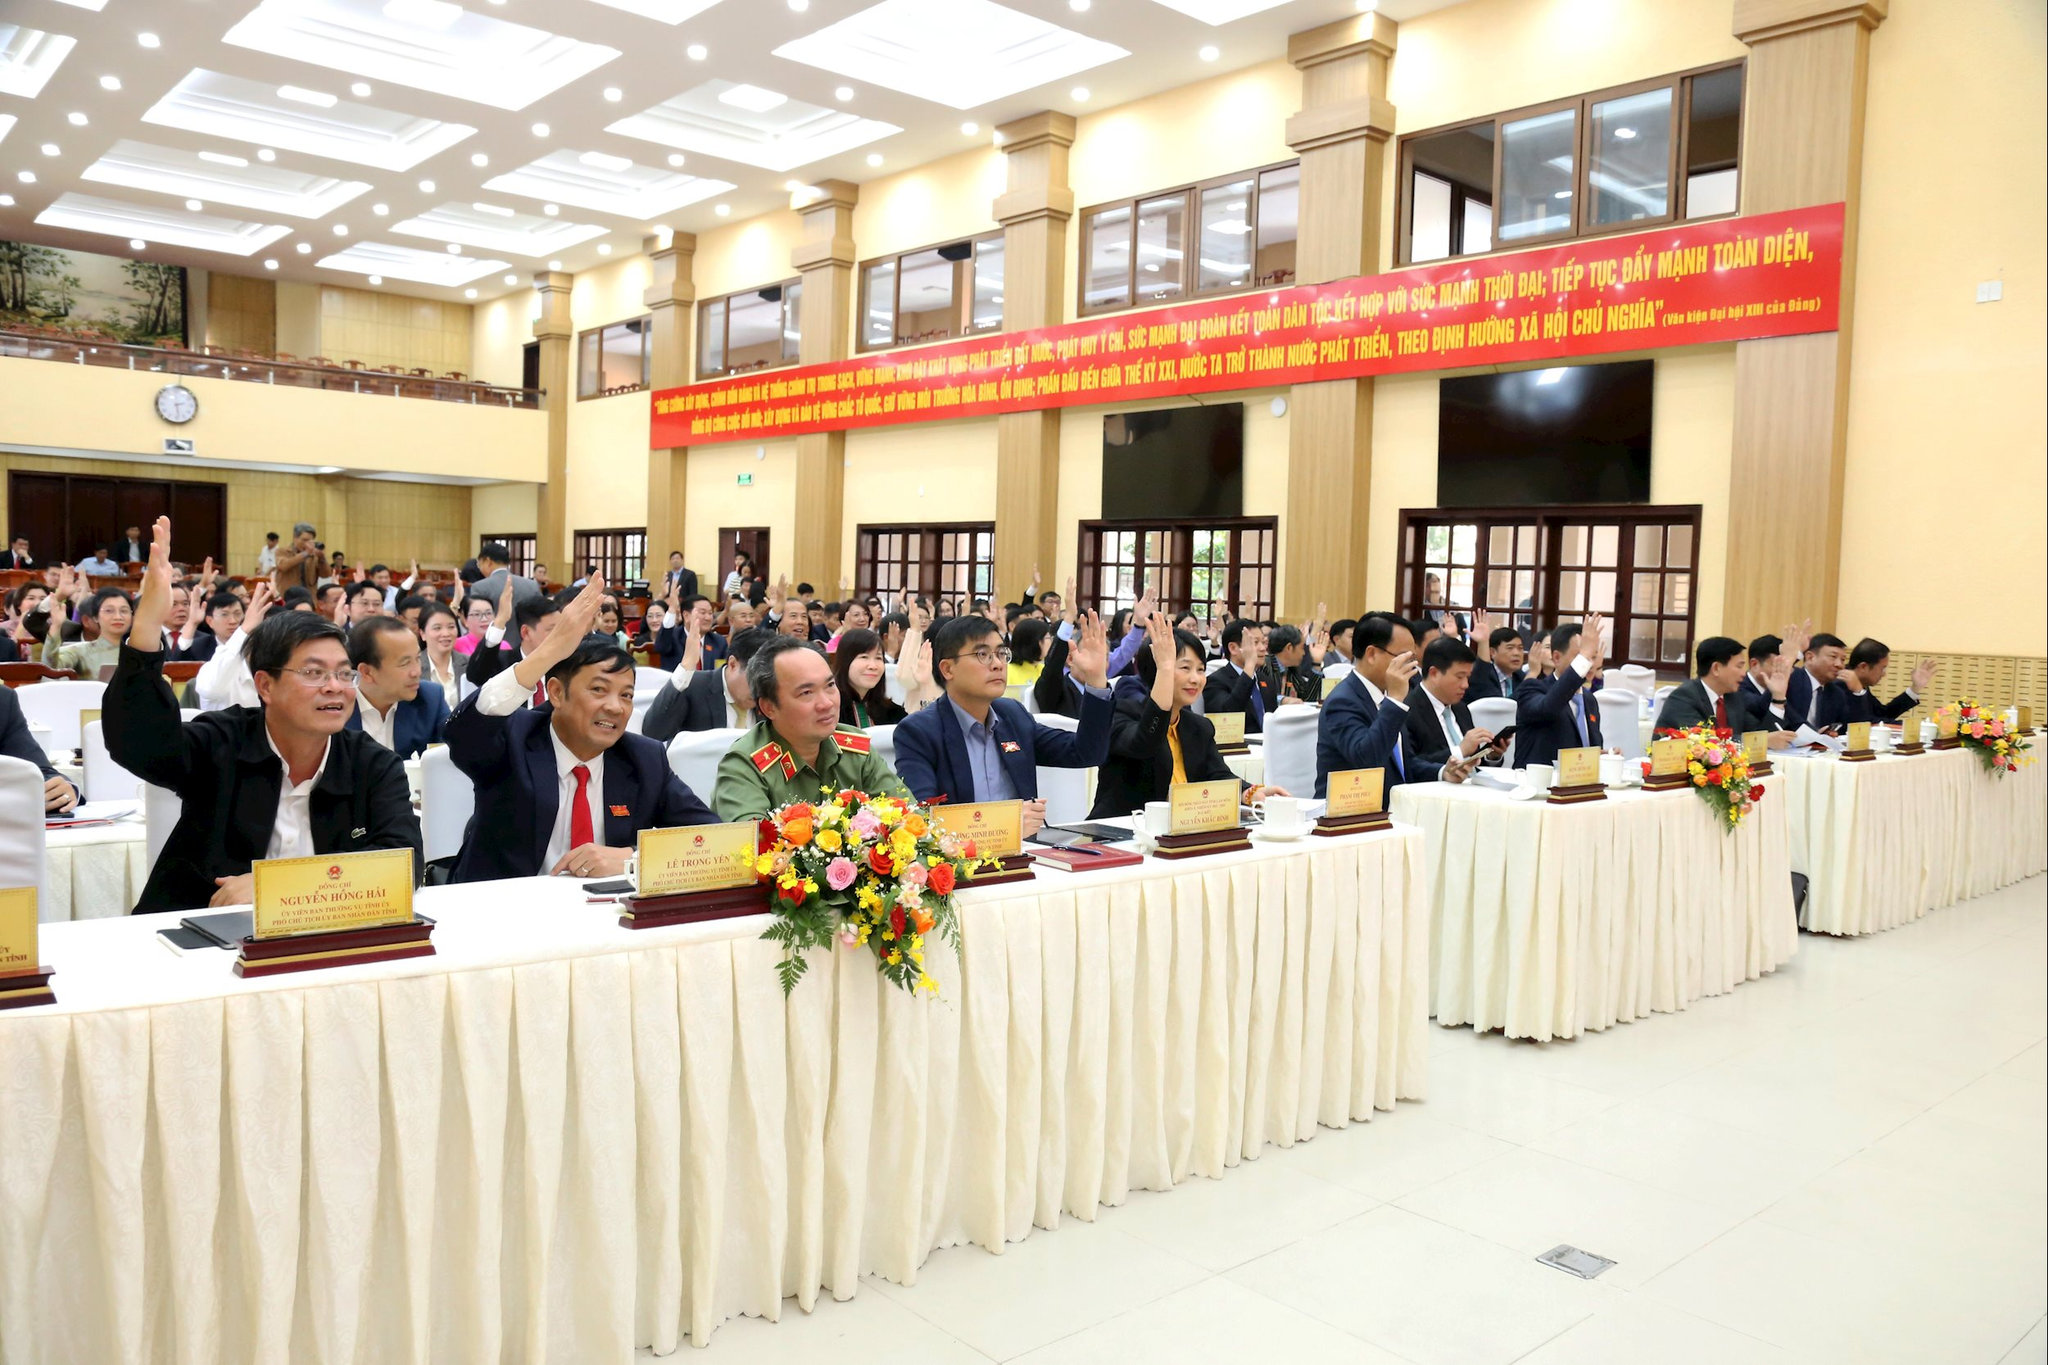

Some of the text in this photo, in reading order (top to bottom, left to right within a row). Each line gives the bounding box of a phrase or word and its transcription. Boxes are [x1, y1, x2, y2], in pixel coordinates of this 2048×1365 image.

[1080, 337, 1097, 357] HUY
[1100, 331, 1106, 354] Ý
[1108, 328, 1126, 354] CHÍ,
[1128, 326, 1146, 349] SỨC
[1149, 324, 1177, 350] MẠNH
[1180, 321, 1197, 347] ĐẠI
[1200, 313, 1227, 340] ĐOÀN
[1230, 307, 1249, 335] KẾT
[1253, 305, 1280, 333] TOÀN
[1284, 302, 1306, 329] DÂN
[1311, 298, 1332, 330] TỘC
[1334, 292, 1355, 323] KẾT
[1360, 294, 1383, 323] HỢP
[1388, 286, 1407, 315] VỚI
[1411, 281, 1435, 311] SỨC
[1440, 279, 1479, 312] MẠNH
[1484, 270, 1513, 301] THỜI
[1518, 269, 1546, 301] ĐẠI;
[1552, 256, 1584, 292] TIẾP
[1589, 259, 1617, 292] TỤC
[1622, 246, 1653, 283] ĐẨY
[1658, 245, 1707, 281] MẠNH
[1713, 234, 1758, 270] TOÀN
[1764, 226, 1813, 266] DIỆN,
[1081, 363, 1099, 390] ĐẾN
[1101, 363, 1121, 388] GIỮA
[1125, 357, 1142, 385] THẾ
[1144, 358, 1156, 383] KỶ
[1158, 360, 1177, 384] XXI,
[1180, 352, 1207, 379] NƯỚC
[1210, 353, 1223, 375] TA
[1226, 346, 1246, 374] TRỞ
[1249, 343, 1284, 371] THÀNH
[1287, 338, 1317, 367] NƯỚC
[1320, 334, 1350, 363] PHÁT
[1354, 326, 1392, 361] TRIỂN,
[1397, 328, 1428, 355] THEO
[1432, 324, 1465, 355] ĐỊNH
[1468, 315, 1515, 346] HƯỚNG
[1520, 309, 1538, 340] XÃ
[1543, 306, 1568, 343] HỘI
[1572, 301, 1603, 335] CHỦ
[1607, 295, 1664, 331] NGHĨA”
[1687, 310, 1707, 325] kiện
[1710, 308, 1726, 323] Đại
[1728, 305, 1744, 320] hội
[1746, 303, 1764, 317] XIII
[1766, 301, 1785, 314] của
[1788, 297, 1821, 312] Đảng)
[666, 858, 678, 868] LÊ
[682, 856, 710, 868] TRỌNG
[318, 882, 337, 890] ĐỒNG
[280, 886, 386, 906] NGUYỄN HỒNG HẢI
[6, 954, 27, 962] TỈNH
